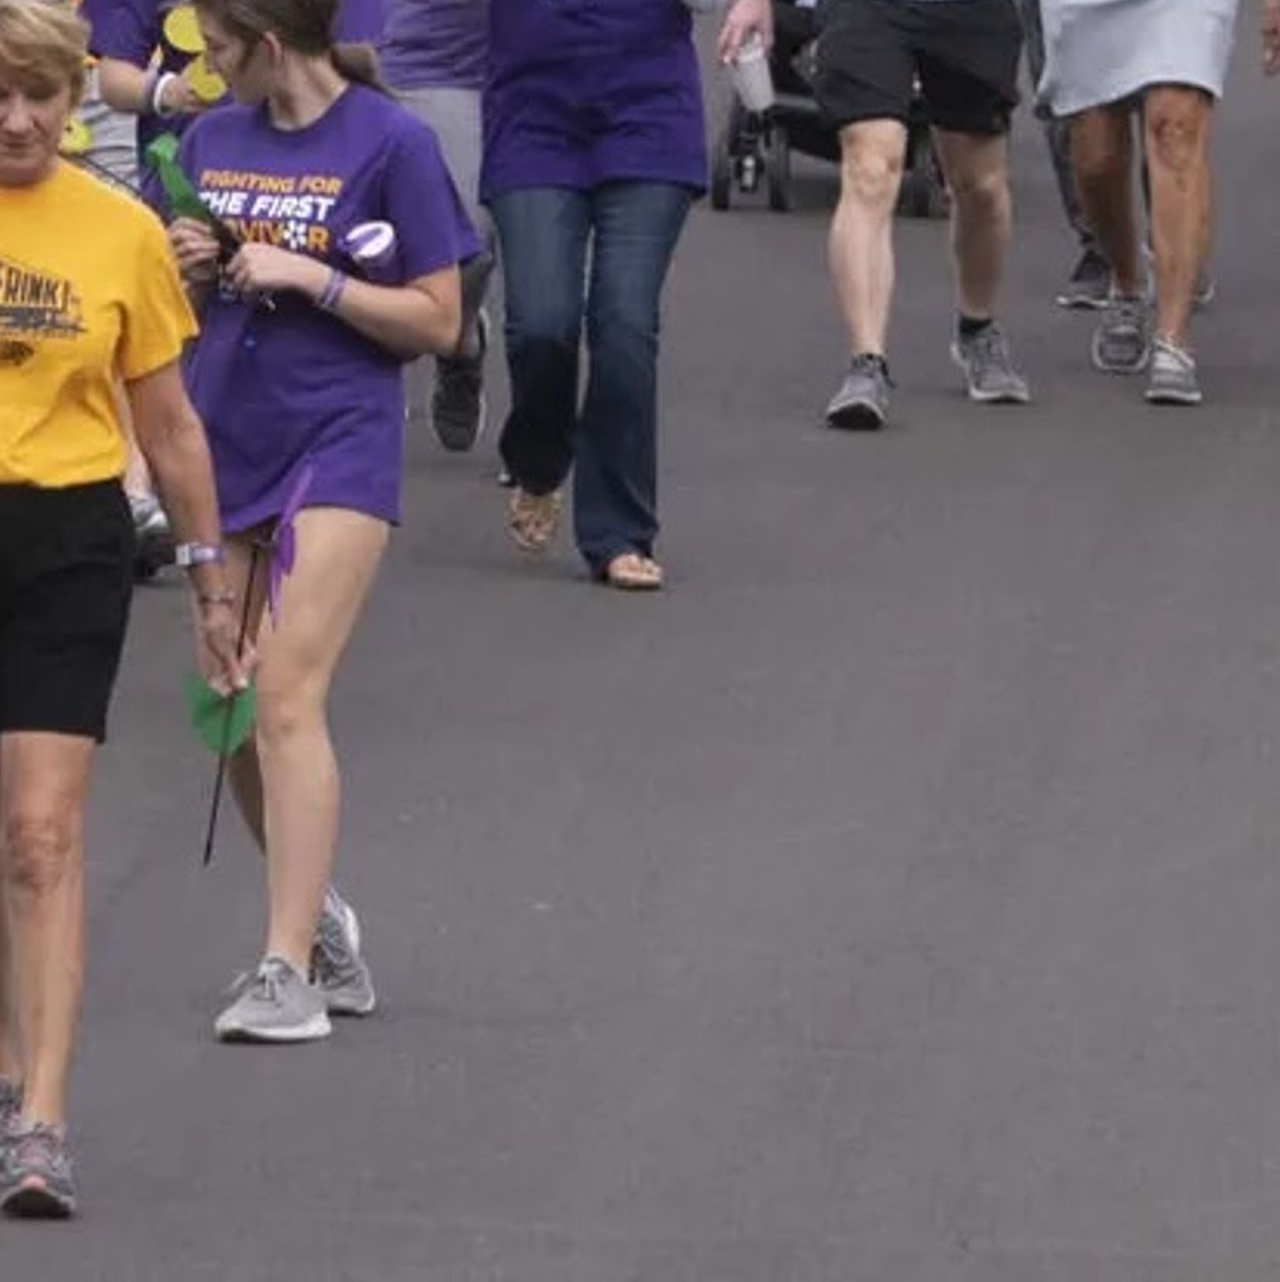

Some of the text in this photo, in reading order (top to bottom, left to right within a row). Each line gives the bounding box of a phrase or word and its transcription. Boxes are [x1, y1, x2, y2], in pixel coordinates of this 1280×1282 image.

[200, 170, 343, 195] FIGHTING FOR
[250, 194, 335, 221] FIRST
